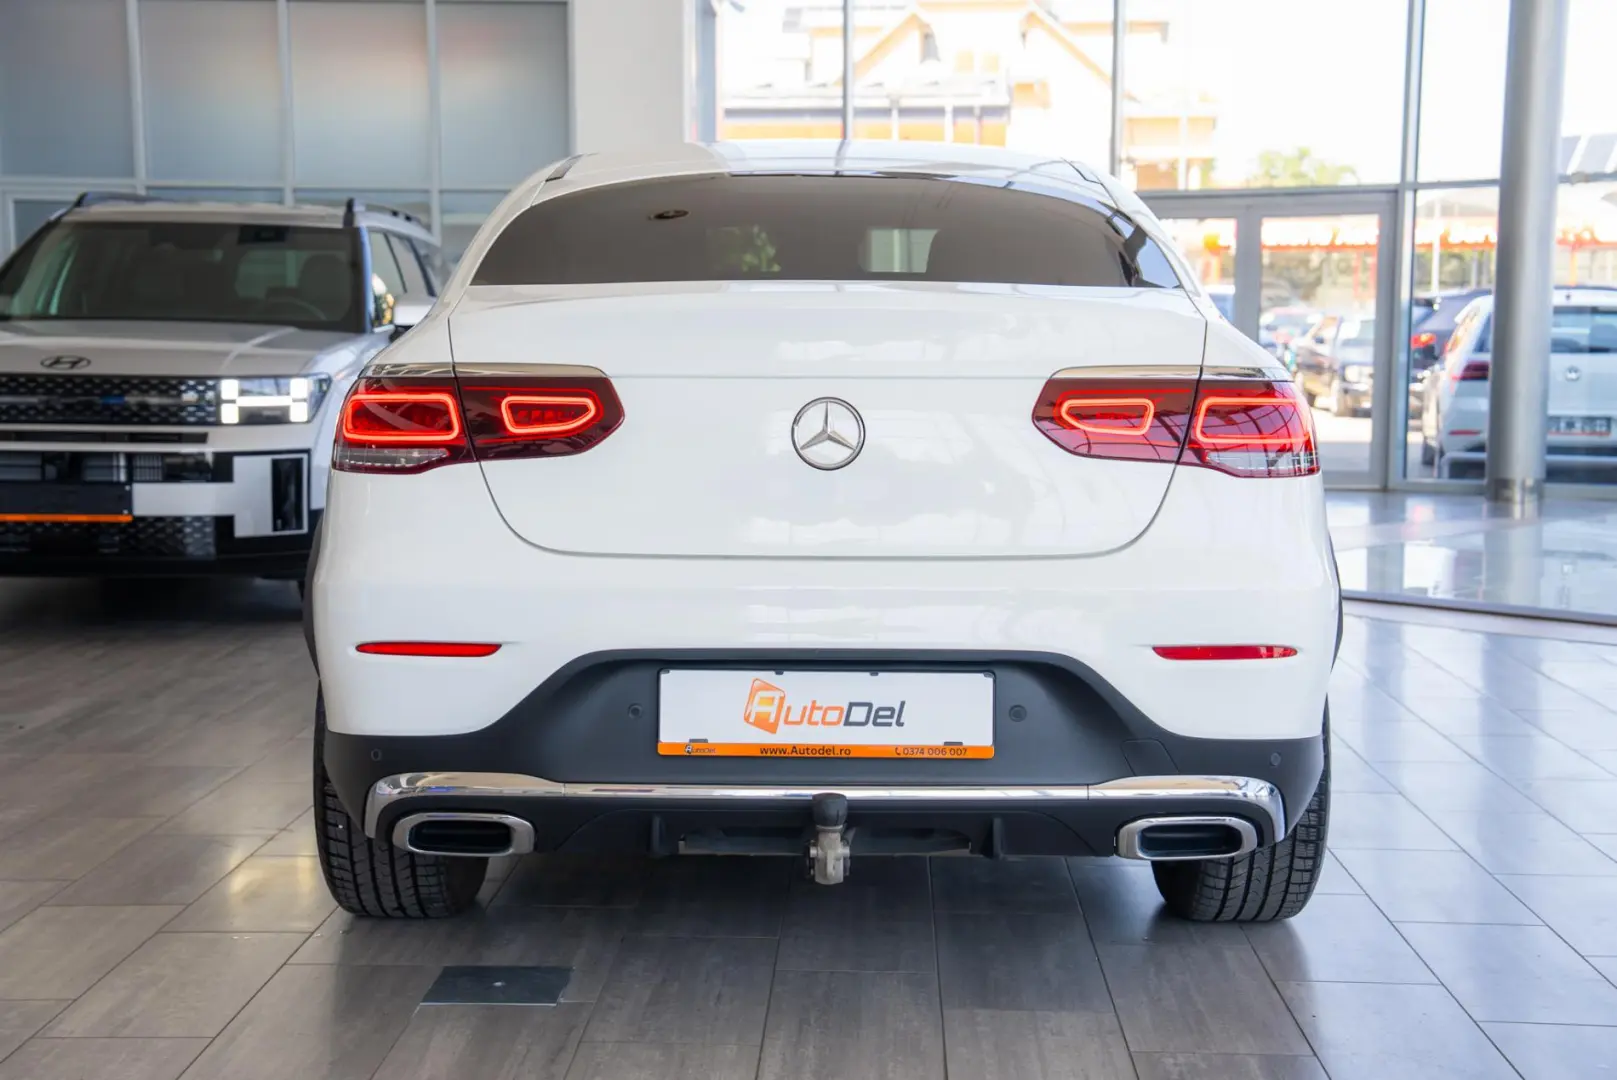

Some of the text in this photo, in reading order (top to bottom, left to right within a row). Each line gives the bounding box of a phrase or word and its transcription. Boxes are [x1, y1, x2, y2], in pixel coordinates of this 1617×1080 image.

[749, 687, 906, 729] AutoDel
[760, 745, 851, 756] www.Autodel.ro
[902, 747, 968, 756] 0374 006 007
